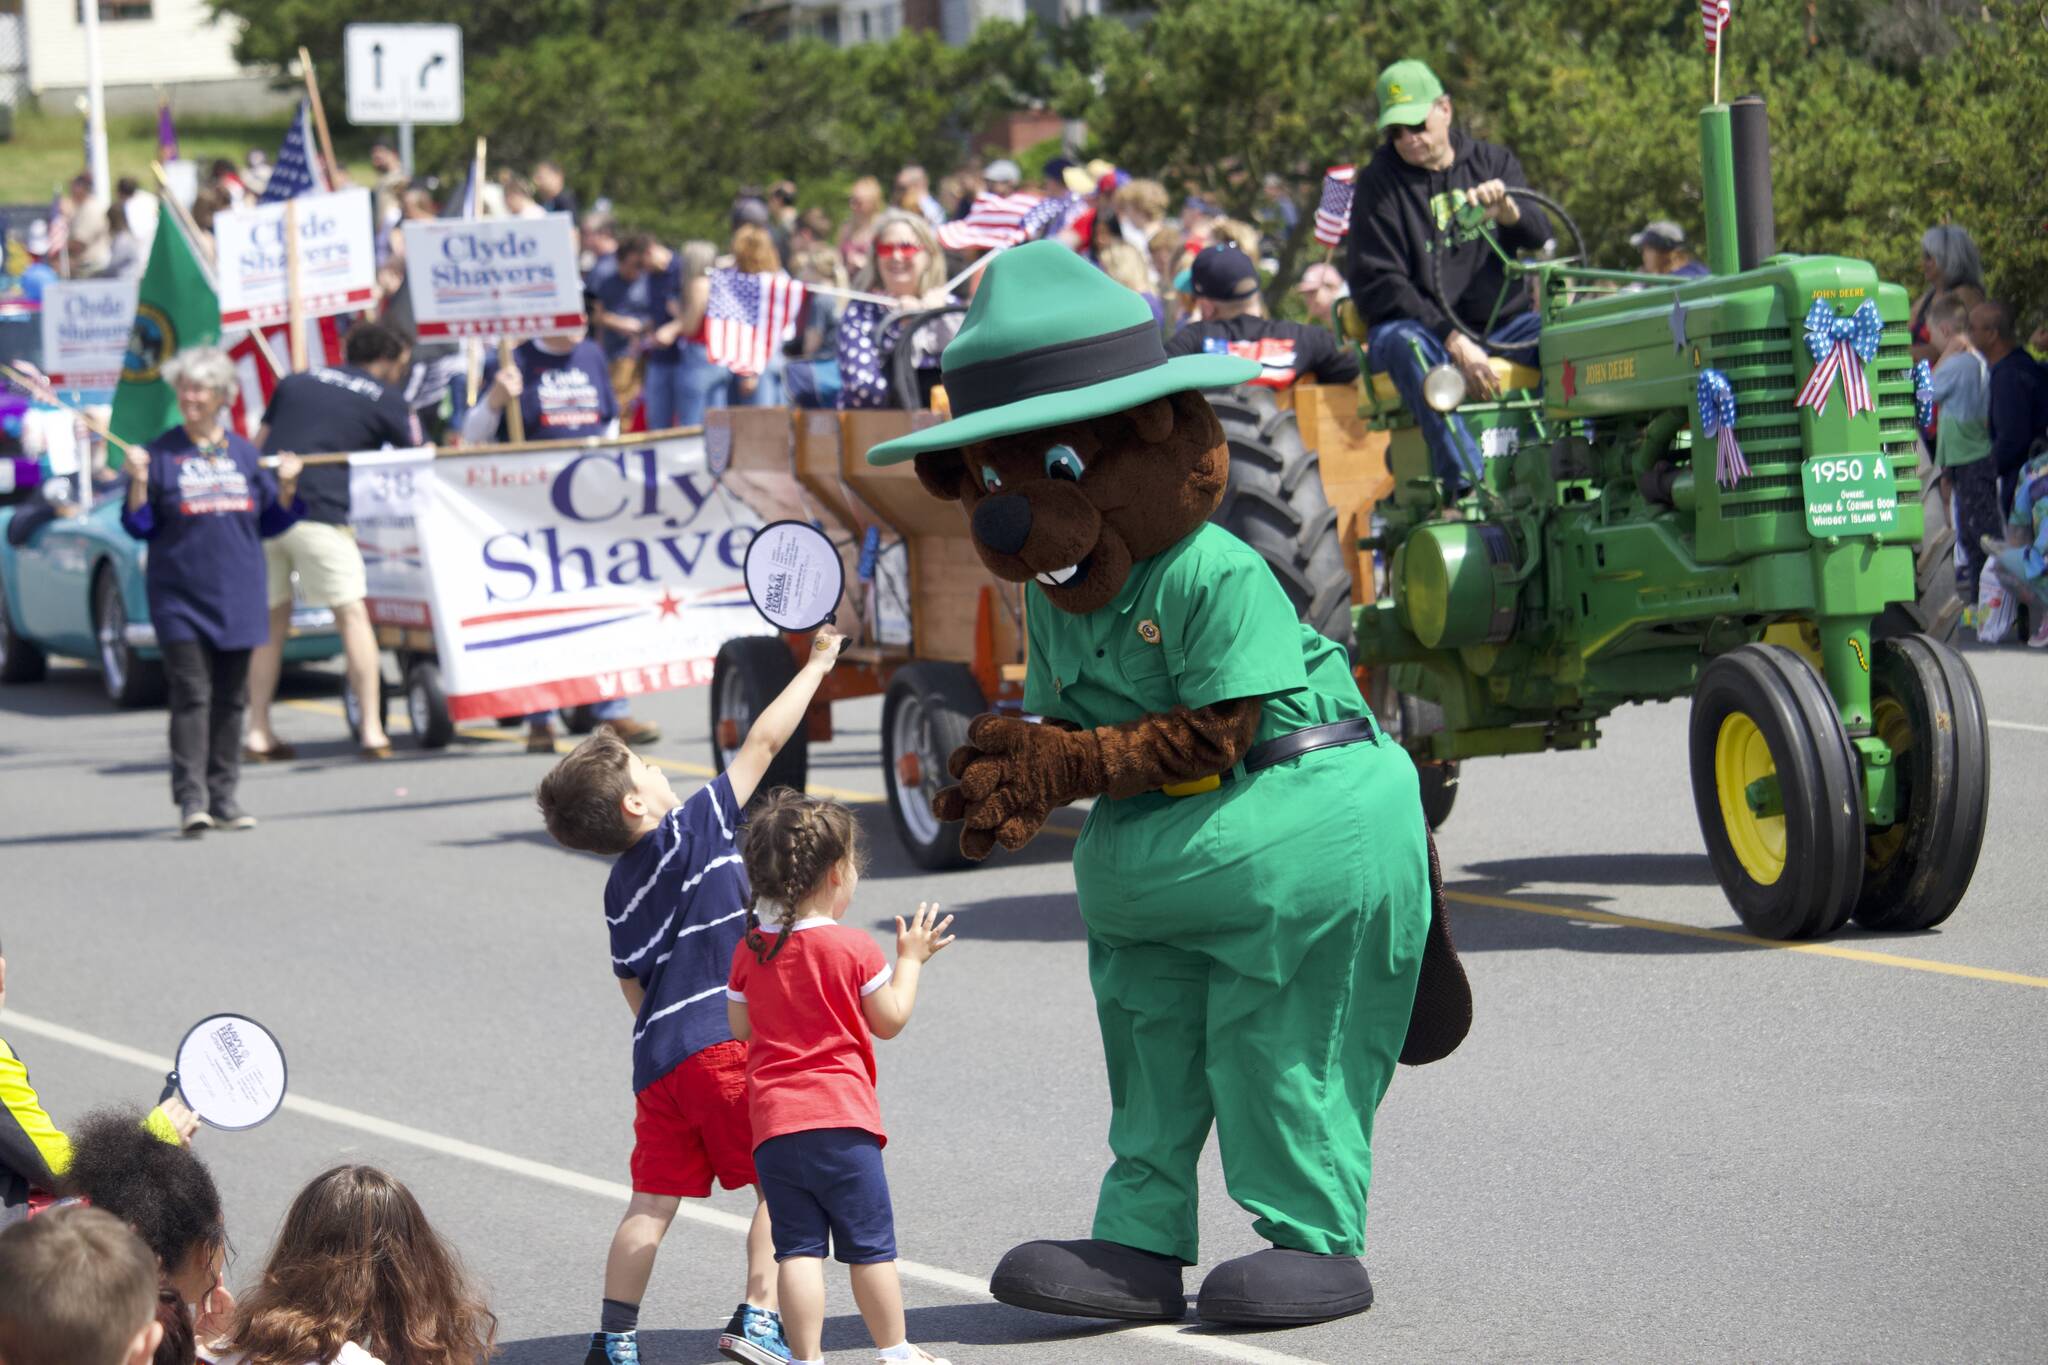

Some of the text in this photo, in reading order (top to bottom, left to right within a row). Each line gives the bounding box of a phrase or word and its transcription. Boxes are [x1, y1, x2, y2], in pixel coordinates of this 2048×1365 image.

[250, 213, 337, 249] Clde
[239, 243, 350, 272] Shaers
[441, 229, 538, 264] Clyde
[431, 262, 556, 288] Shavers
[1811, 287, 1865, 299] JOHN DEERE
[448, 315, 552, 336] VETERAN
[1586, 357, 1636, 384] JOHN DEERE
[464, 465, 550, 489] Elect
[1811, 457, 1887, 484] 1950 A
[370, 467, 416, 502] 38
[1850, 511, 1877, 524] ISLAND
[1879, 510, 1893, 523] WA
[764, 584, 774, 611] NAVY
[771, 573, 785, 614] FEDERAL
[219, 1026, 244, 1066] FEDERAL
[226, 1022, 245, 1048] NAVY
